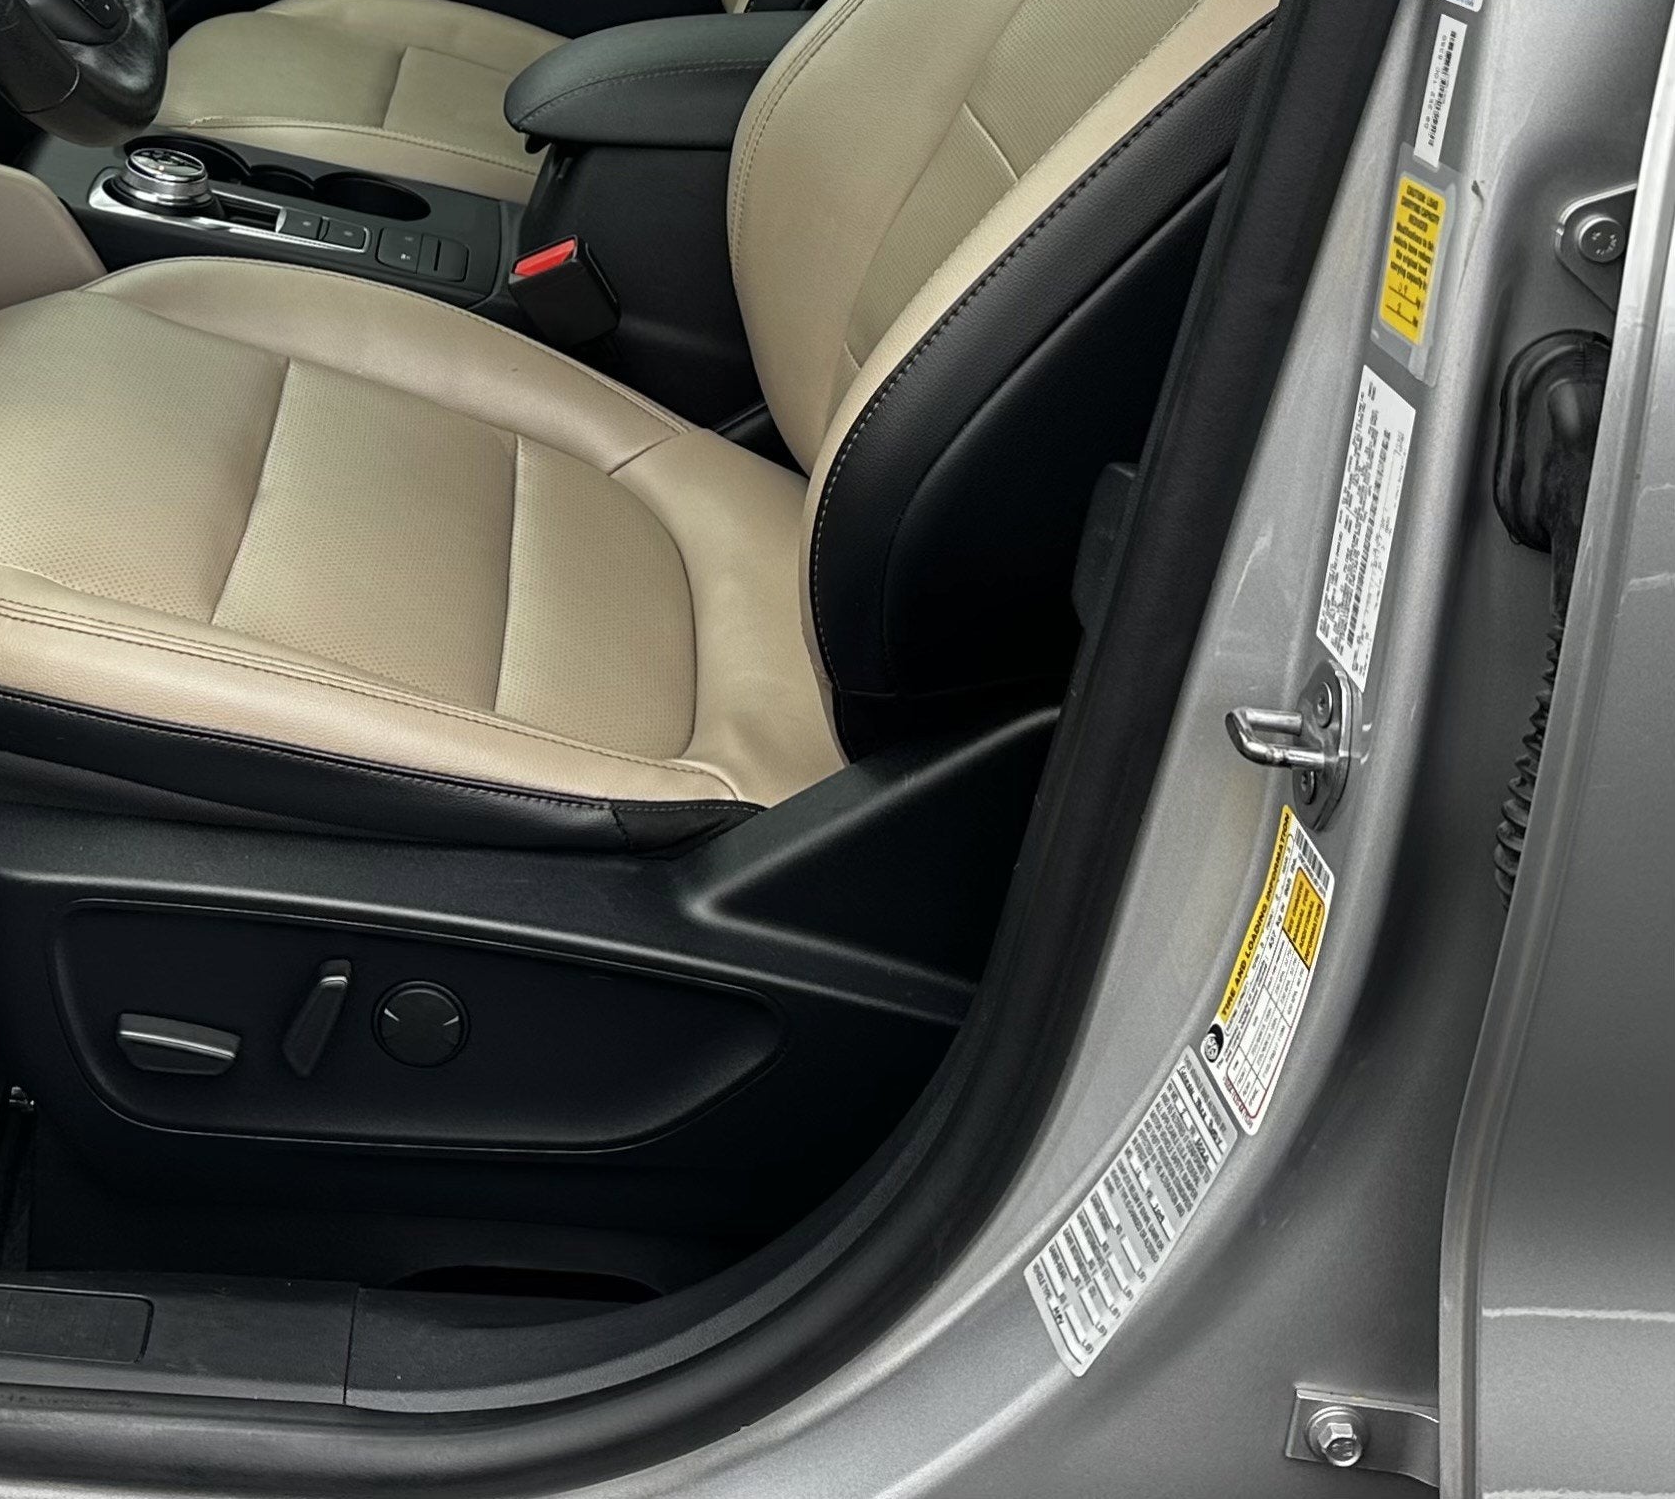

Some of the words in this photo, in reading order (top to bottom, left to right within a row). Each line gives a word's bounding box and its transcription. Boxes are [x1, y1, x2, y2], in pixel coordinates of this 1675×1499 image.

[1221, 986, 1236, 1017] TIRE
[1233, 957, 1247, 987] AND
[1244, 900, 1267, 960] LOADING
[1263, 811, 1291, 902] INFORMATION
[1292, 907, 1304, 943] MANUAL
[1298, 897, 1314, 950] ADDITIONAL
[1303, 900, 1322, 962] INFORMATION
